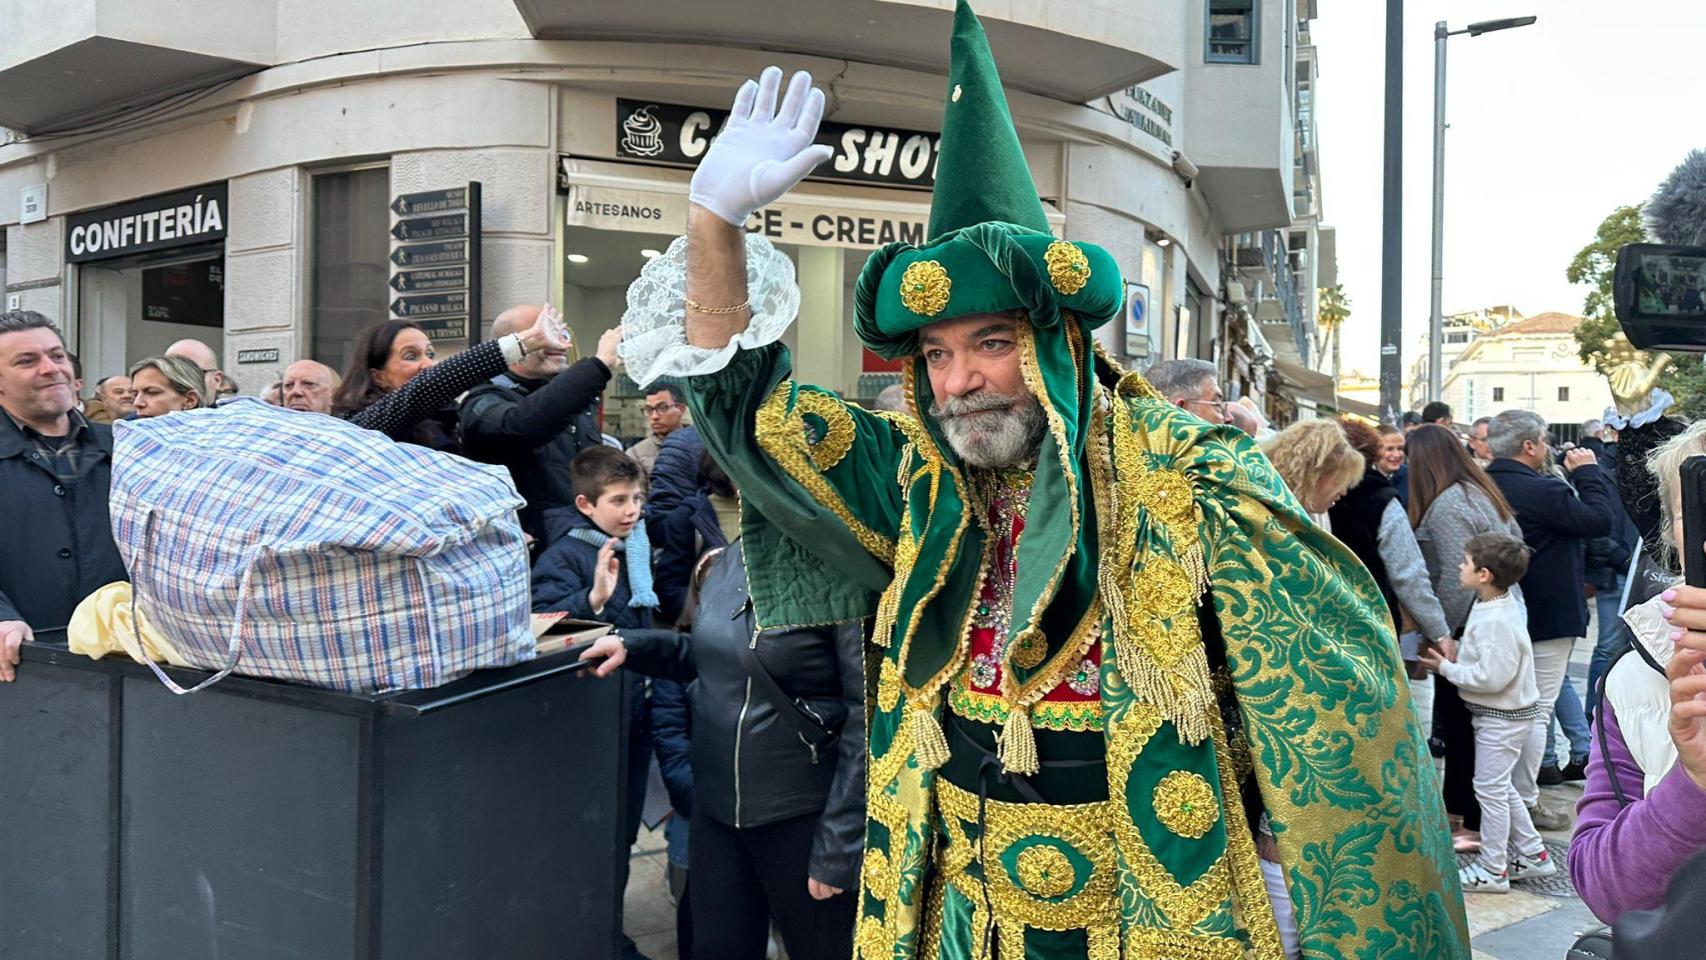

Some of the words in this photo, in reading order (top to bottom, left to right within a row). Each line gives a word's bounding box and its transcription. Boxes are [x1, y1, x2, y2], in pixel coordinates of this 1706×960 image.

[70, 194, 223, 255] CONFITERÍA
[576, 201, 662, 220] ARTESANOS
[743, 209, 782, 237] CE
[812, 214, 924, 245] CREAM
